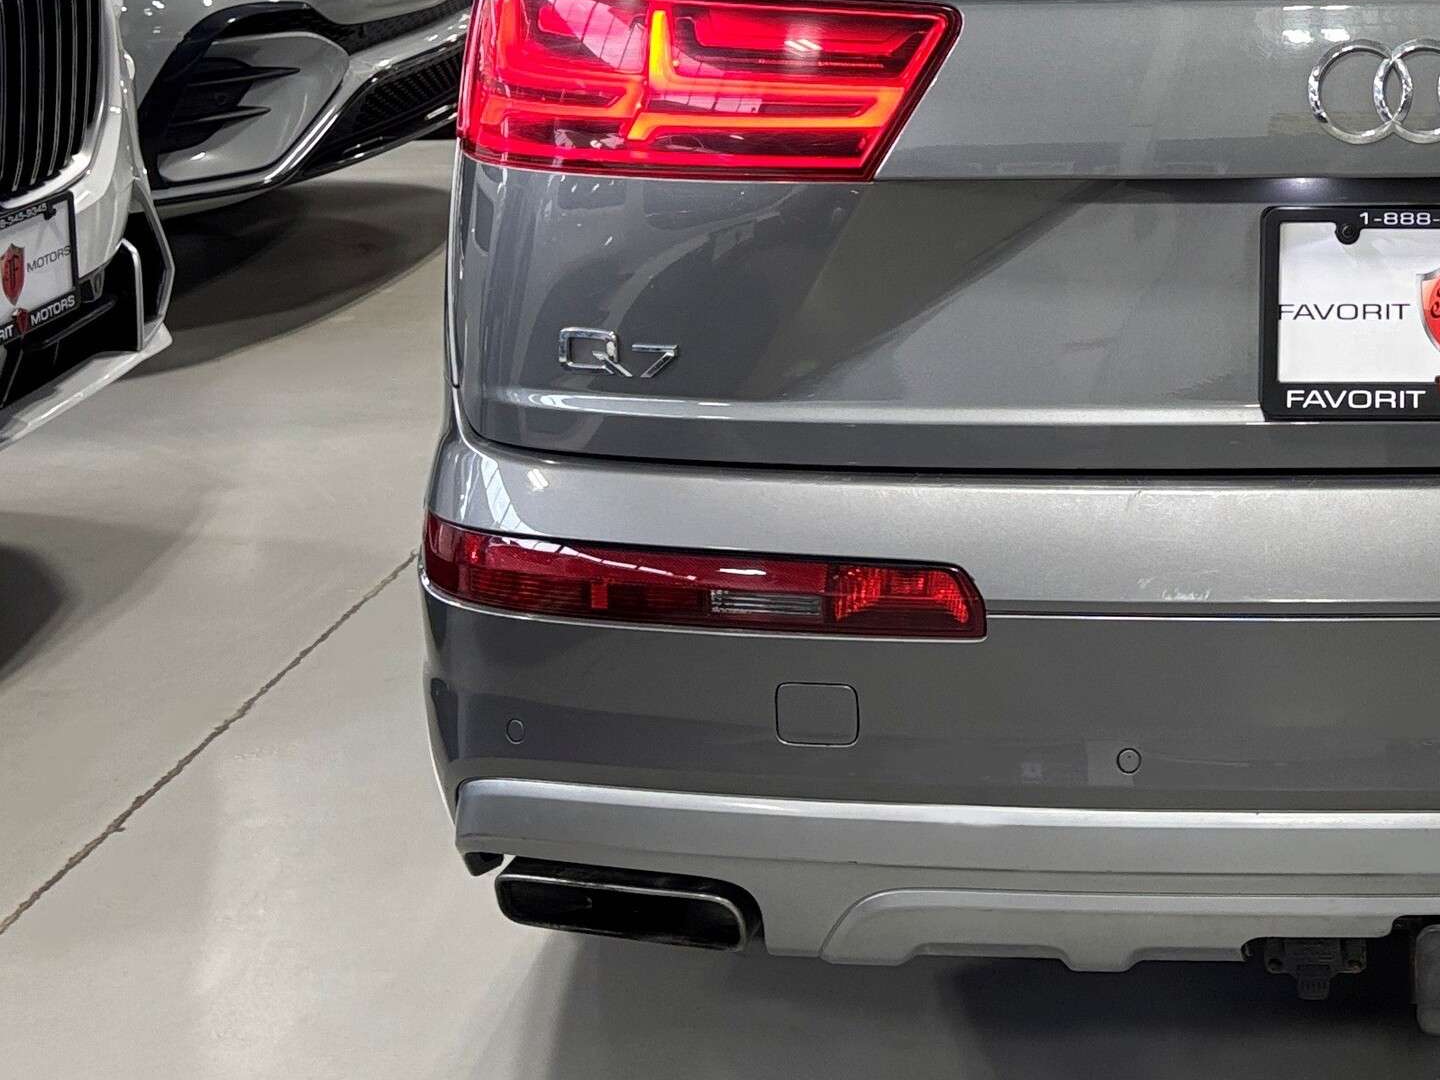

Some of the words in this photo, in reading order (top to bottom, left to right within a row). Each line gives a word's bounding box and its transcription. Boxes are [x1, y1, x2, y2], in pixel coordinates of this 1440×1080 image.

[26, 245, 71, 272] MOTORS
[30, 294, 75, 327] MOTORS
[1278, 303, 1411, 321] FAVORIT
[558, 326, 679, 378] Q7
[1286, 389, 1427, 410] FAVORIT
